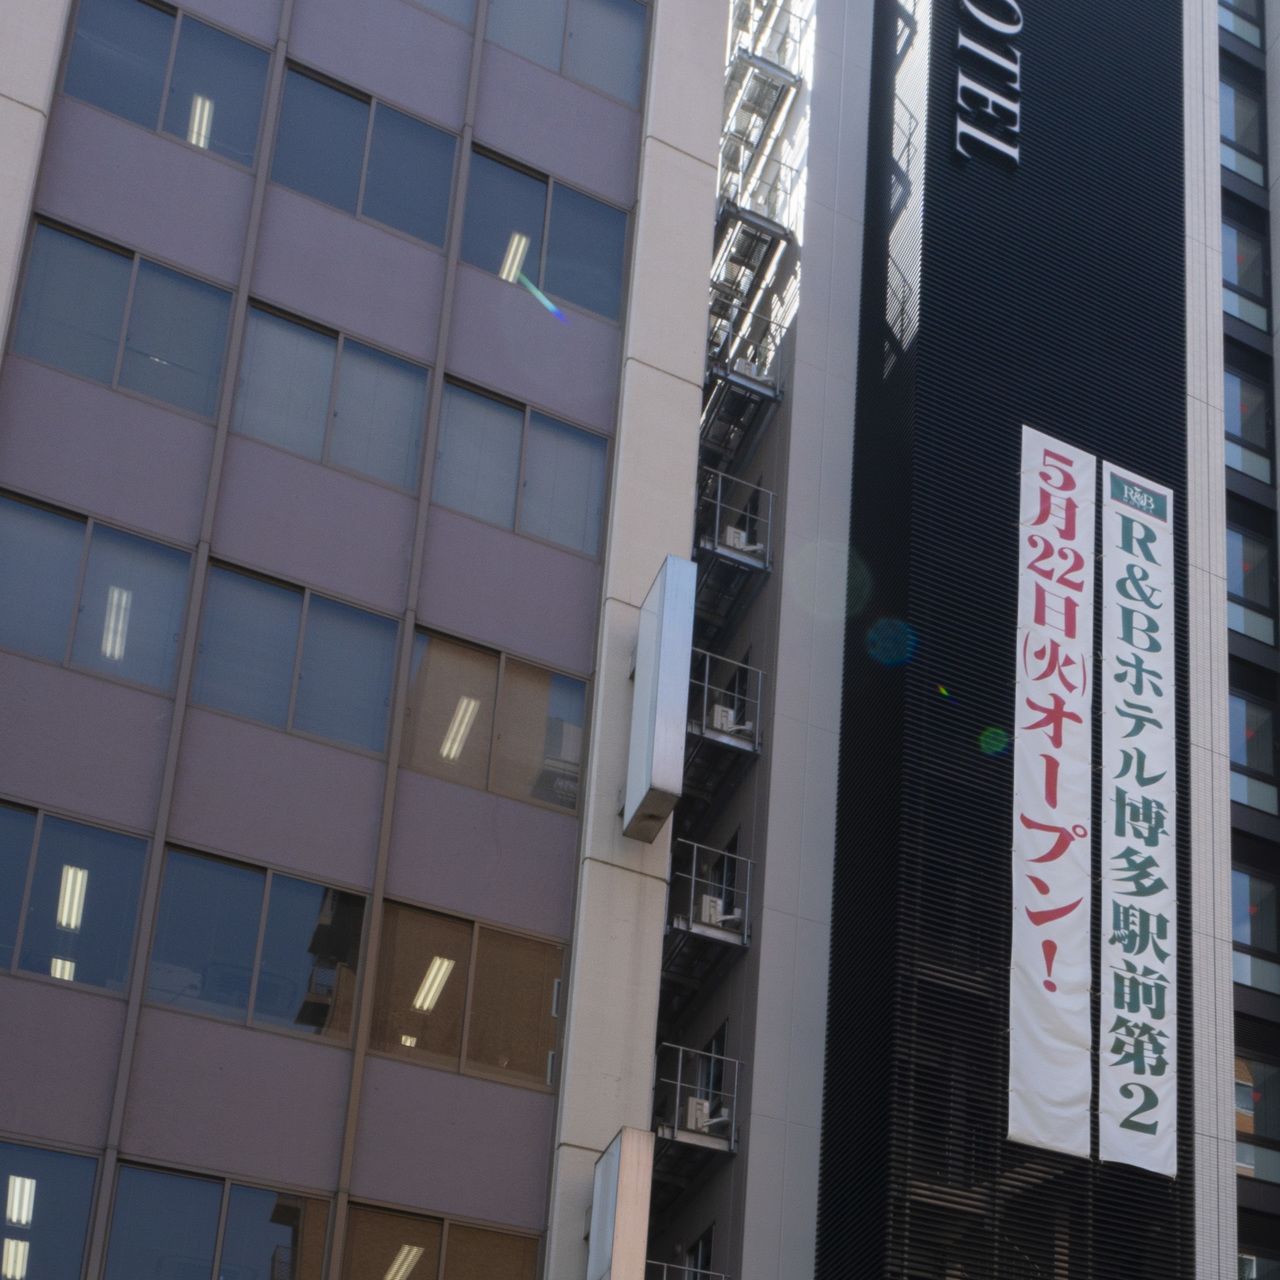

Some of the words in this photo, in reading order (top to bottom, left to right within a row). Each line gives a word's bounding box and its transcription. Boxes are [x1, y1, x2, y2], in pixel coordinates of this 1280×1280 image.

[1107, 510, 1171, 1137] R&Bホテル博多駅前第2
